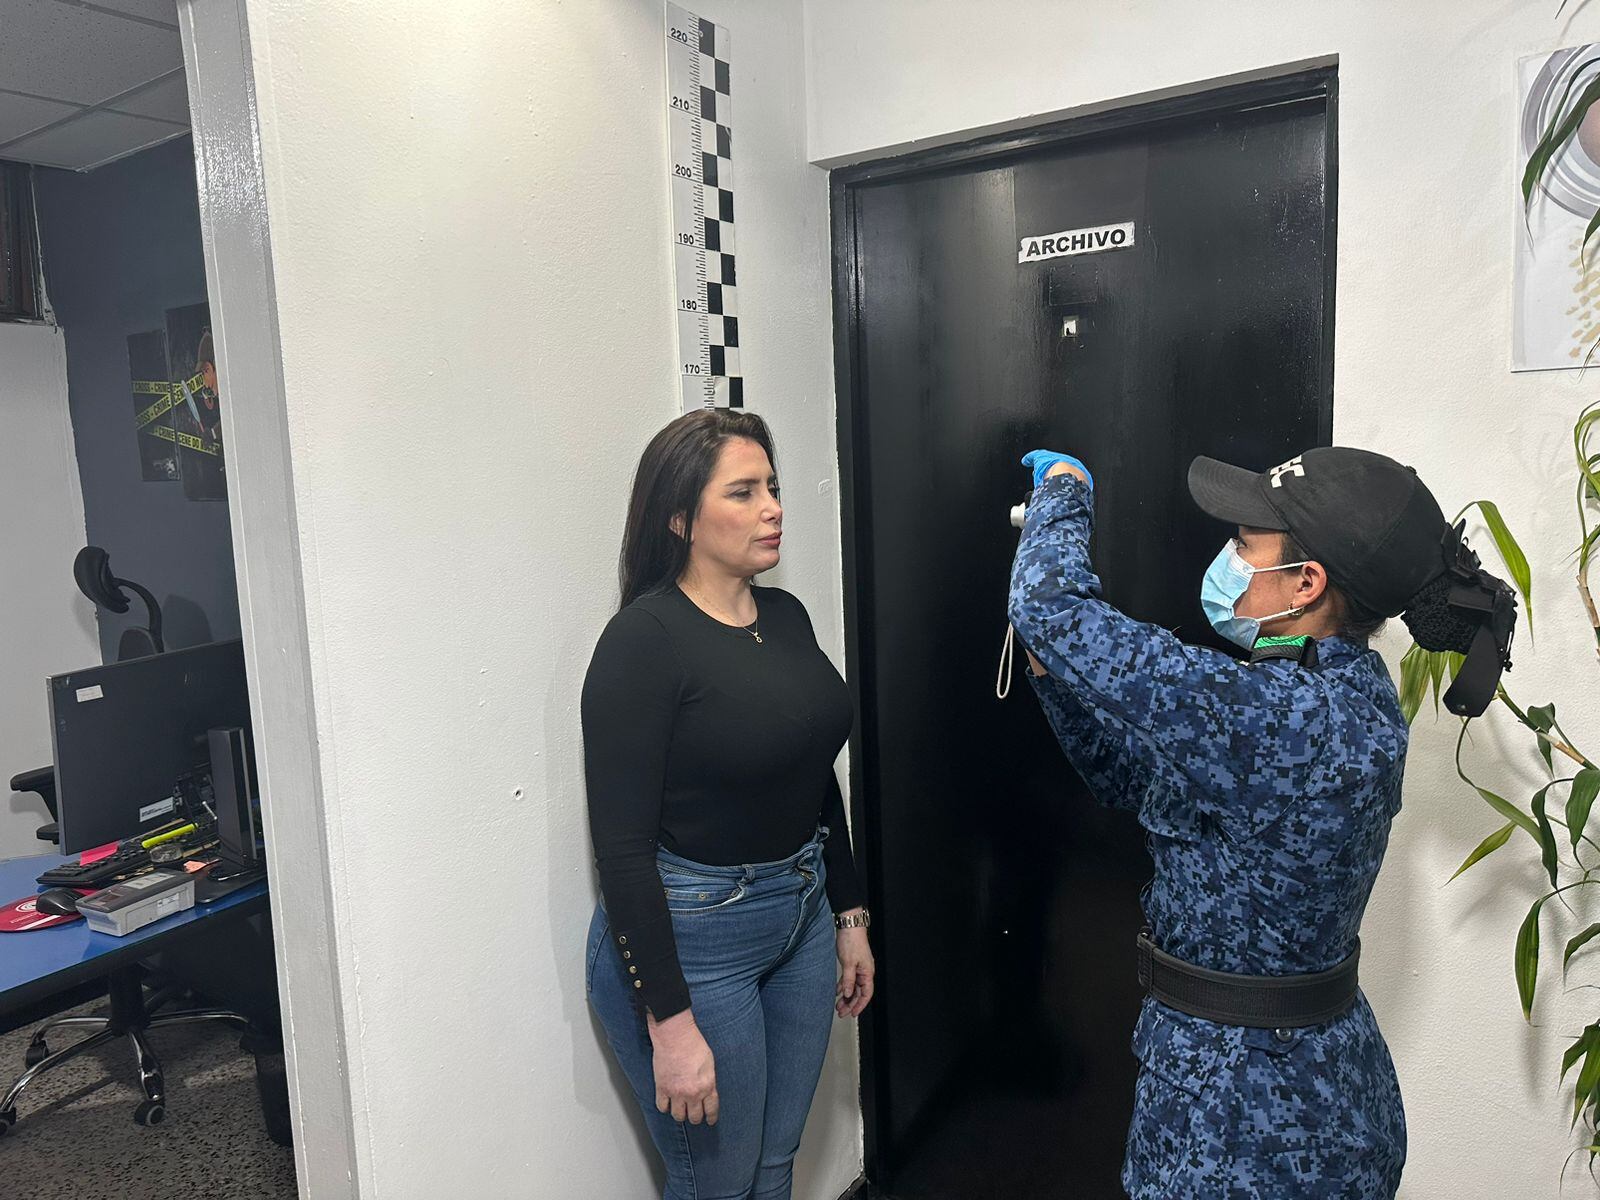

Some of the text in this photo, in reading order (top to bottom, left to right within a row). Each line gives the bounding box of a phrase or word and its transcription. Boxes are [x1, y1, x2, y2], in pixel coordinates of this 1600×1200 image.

[670, 27, 688, 43] 220
[672, 96, 690, 111] 210
[675, 164, 692, 178] 200
[678, 232, 694, 245] 190
[1026, 228, 1126, 257] ARCHIVO
[681, 299, 697, 311] 180
[684, 363, 700, 375] 170
[154, 383, 170, 393] CRIME
